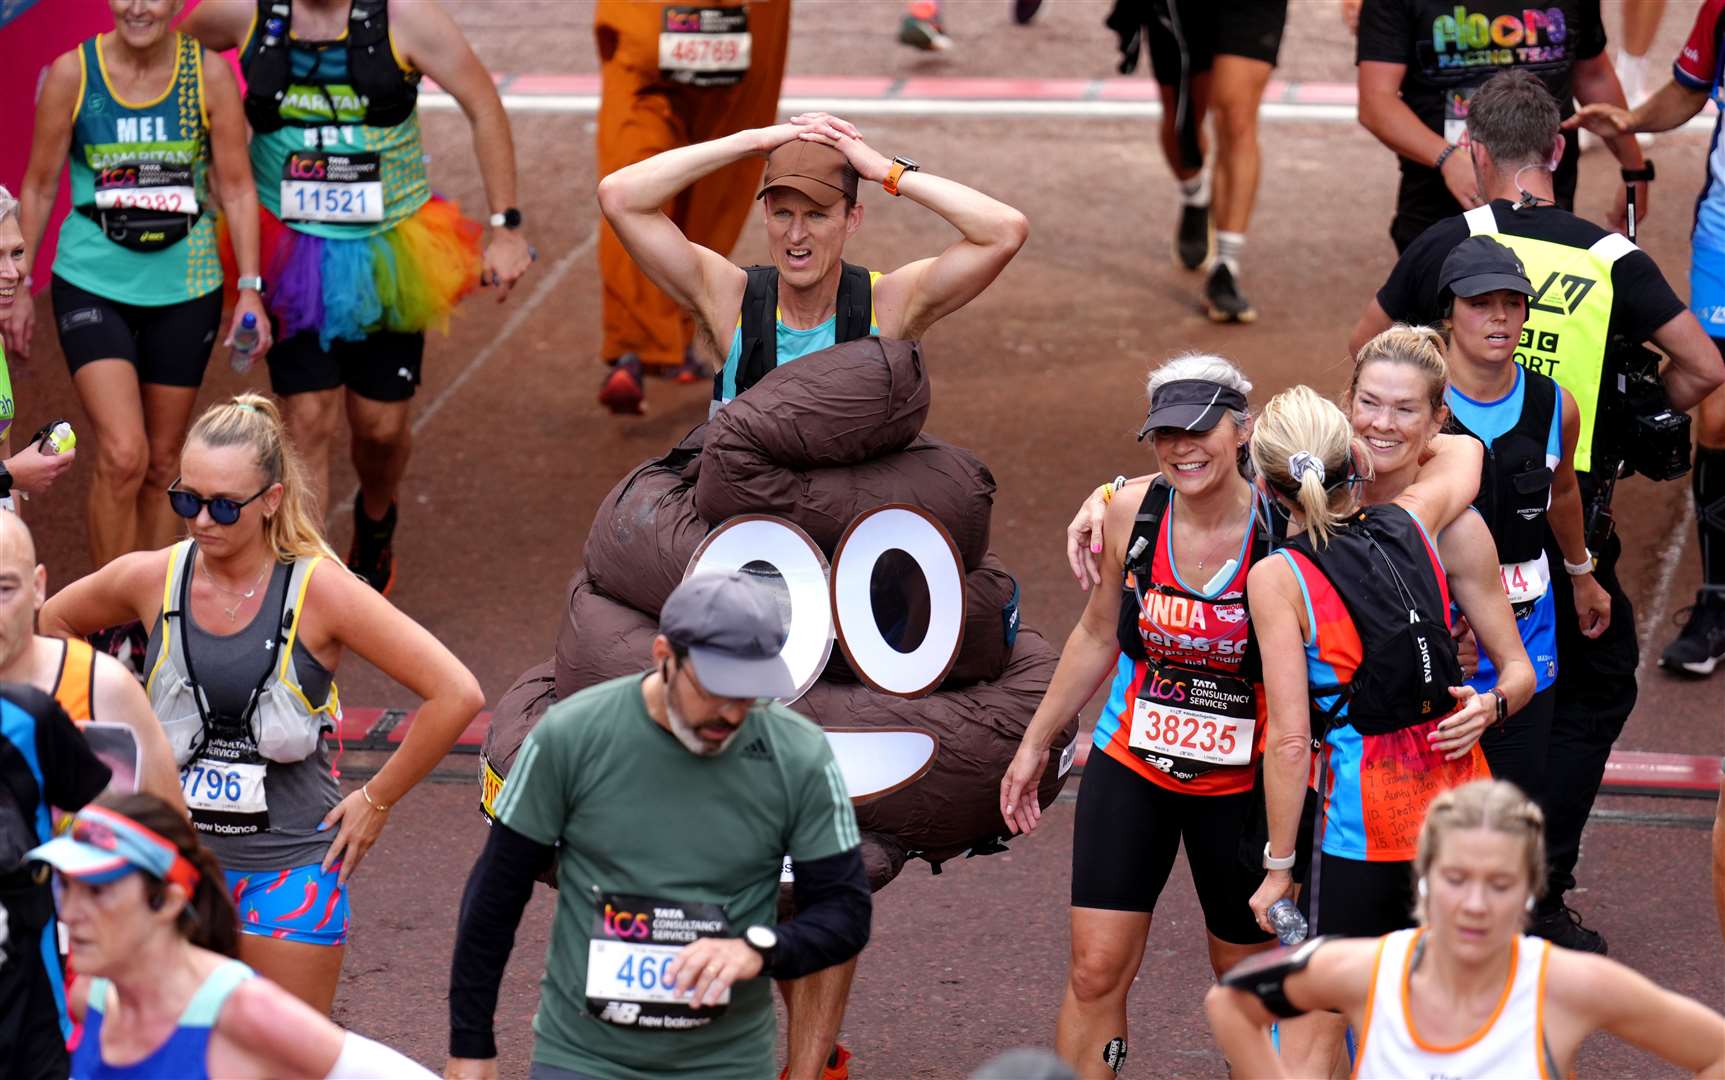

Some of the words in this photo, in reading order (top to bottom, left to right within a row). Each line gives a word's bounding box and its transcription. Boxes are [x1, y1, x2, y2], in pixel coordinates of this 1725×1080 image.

[116, 116, 168, 142] MEL
[290, 154, 326, 177] tcs
[101, 168, 136, 186] tcs
[294, 188, 366, 212] 11521
[1513, 352, 1560, 376] ORT
[1417, 636, 1432, 683] EVADICT
[1149, 670, 1186, 702] tcs
[1191, 678, 1217, 690] TATA
[1189, 696, 1228, 710] SERVICES
[1190, 687, 1250, 704] CONSULTANCY
[1145, 710, 1238, 755] 38235
[194, 821, 213, 831] new
[214, 822, 258, 834] balance
[604, 904, 650, 937] tcs
[653, 907, 685, 920] TATA
[652, 919, 723, 933] CONSULTANCY
[638, 1014, 663, 1027] new
